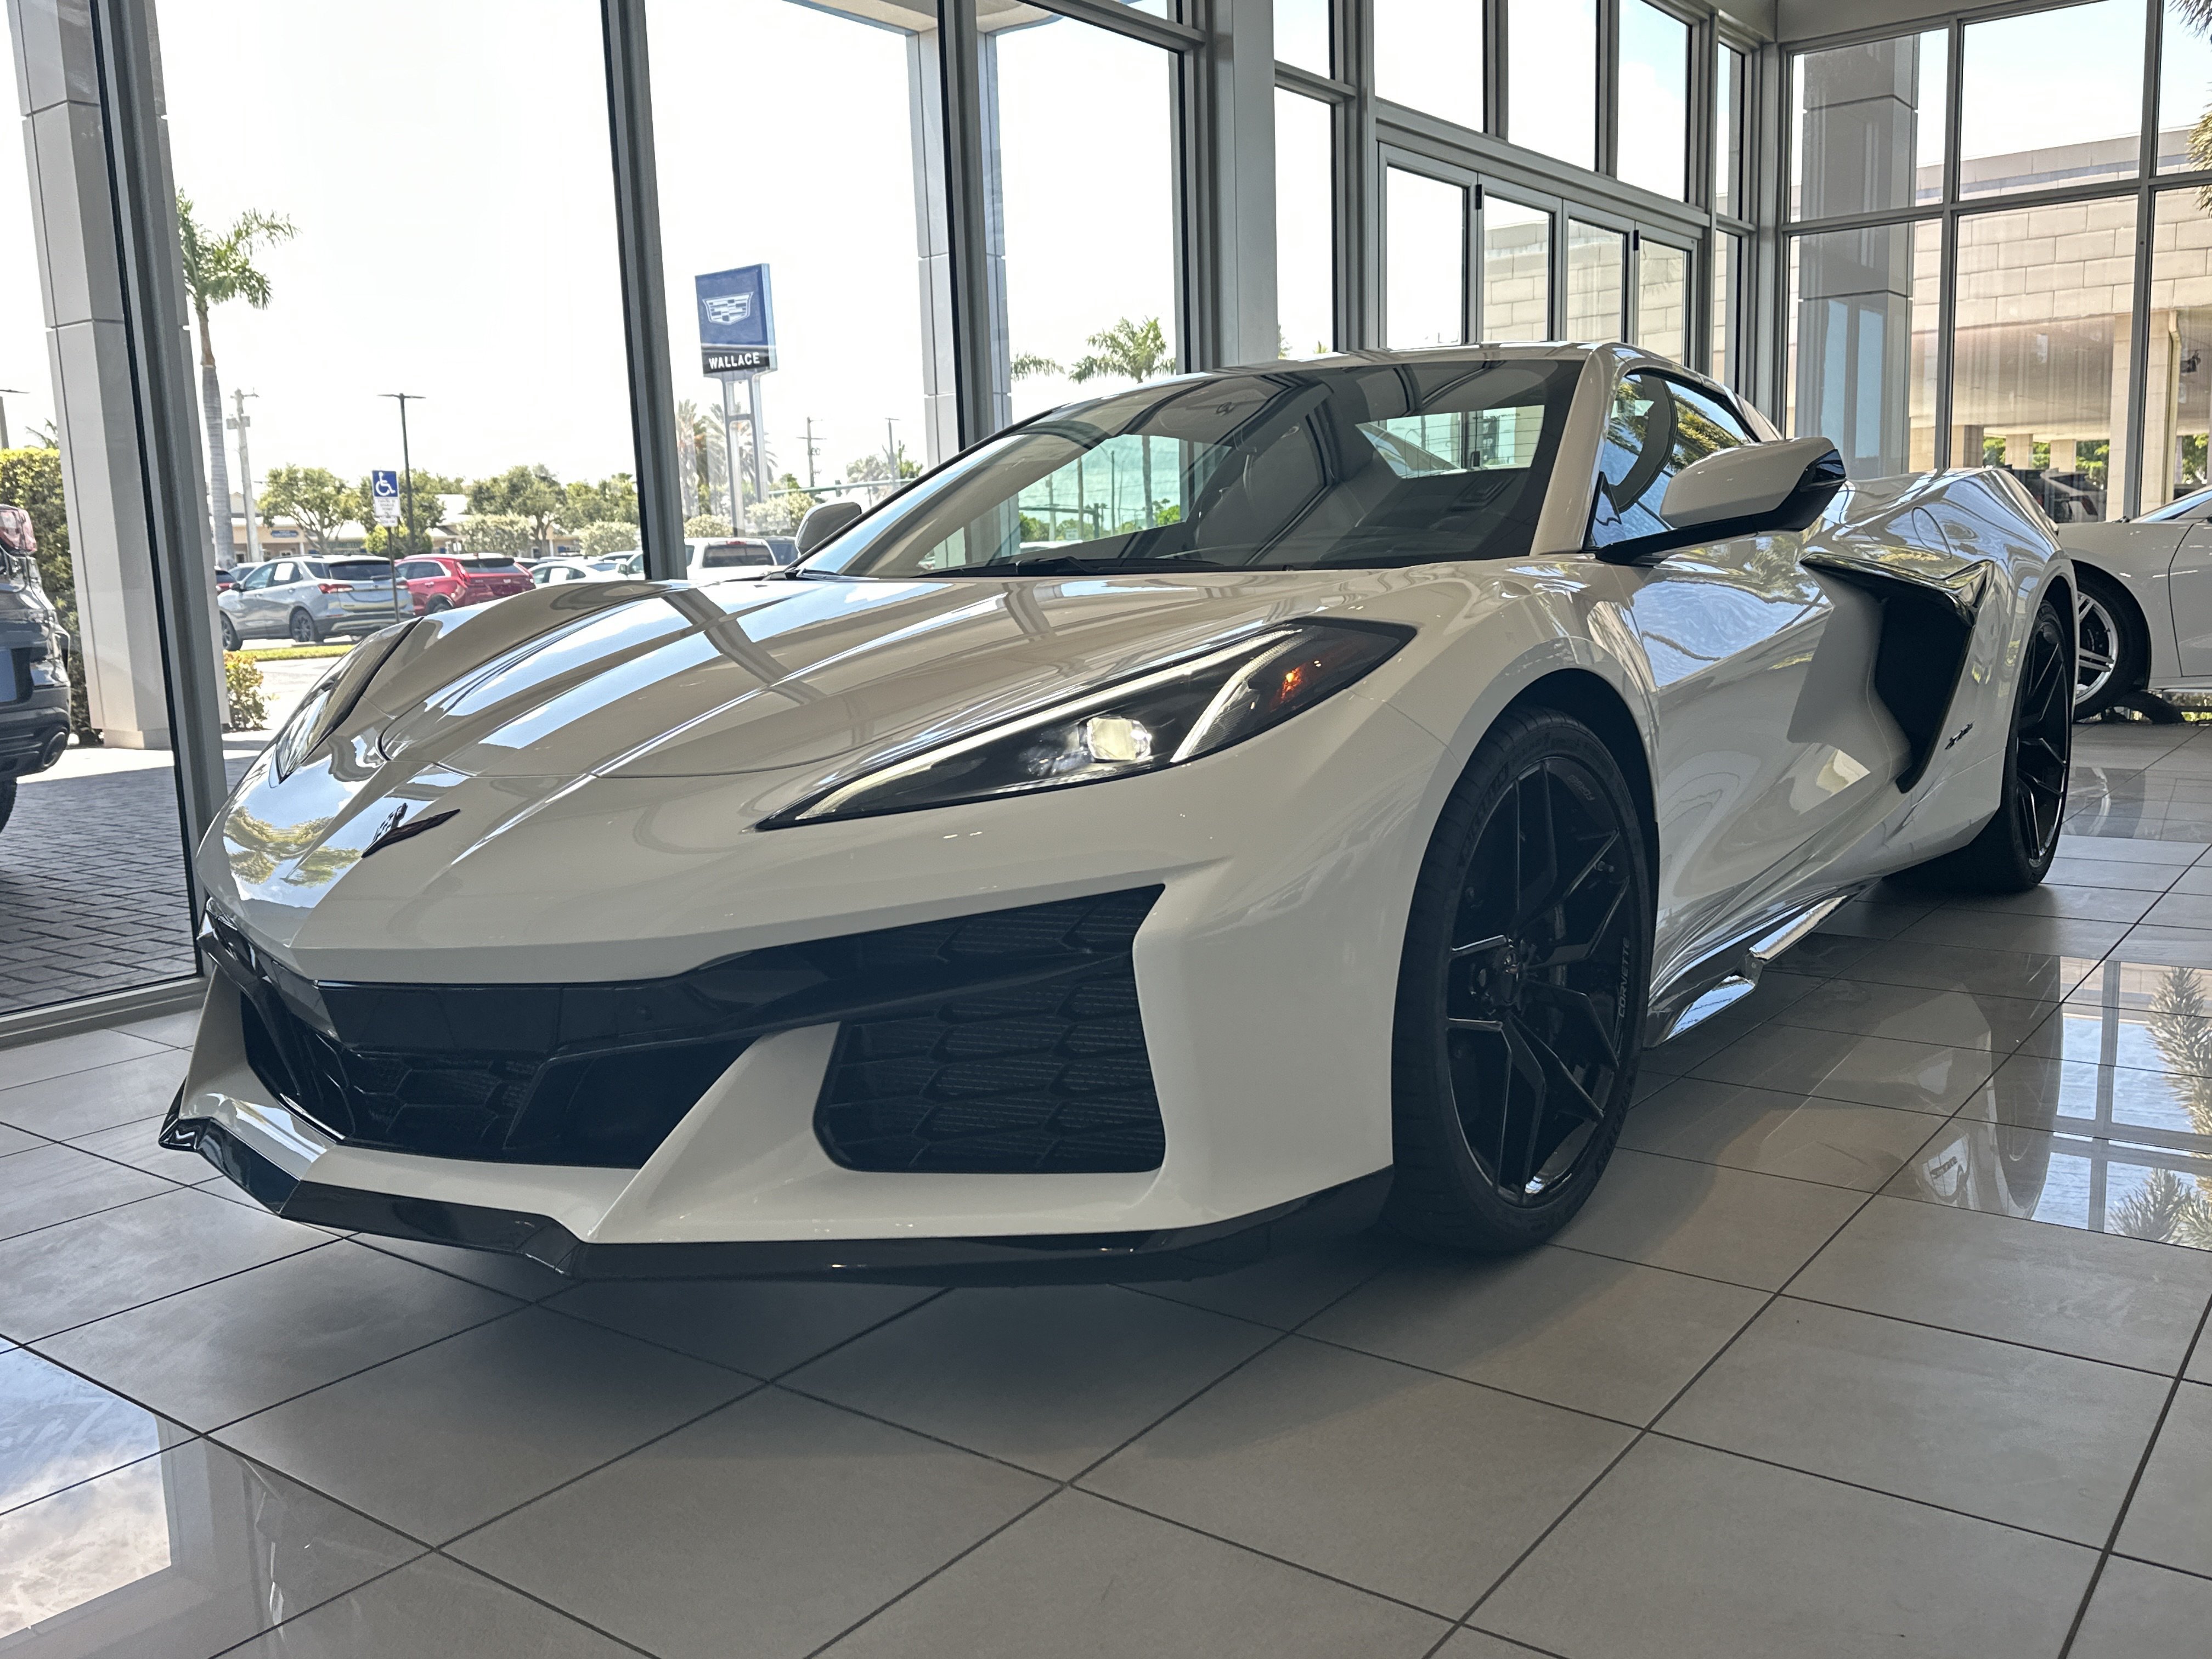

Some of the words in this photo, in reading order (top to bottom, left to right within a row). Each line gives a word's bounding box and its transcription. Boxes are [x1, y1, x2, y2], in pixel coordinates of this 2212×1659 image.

[709, 352, 760, 369] WALLACE
[1567, 774, 1595, 800] FORGED
[1618, 937, 1630, 1018] CORVETTE
